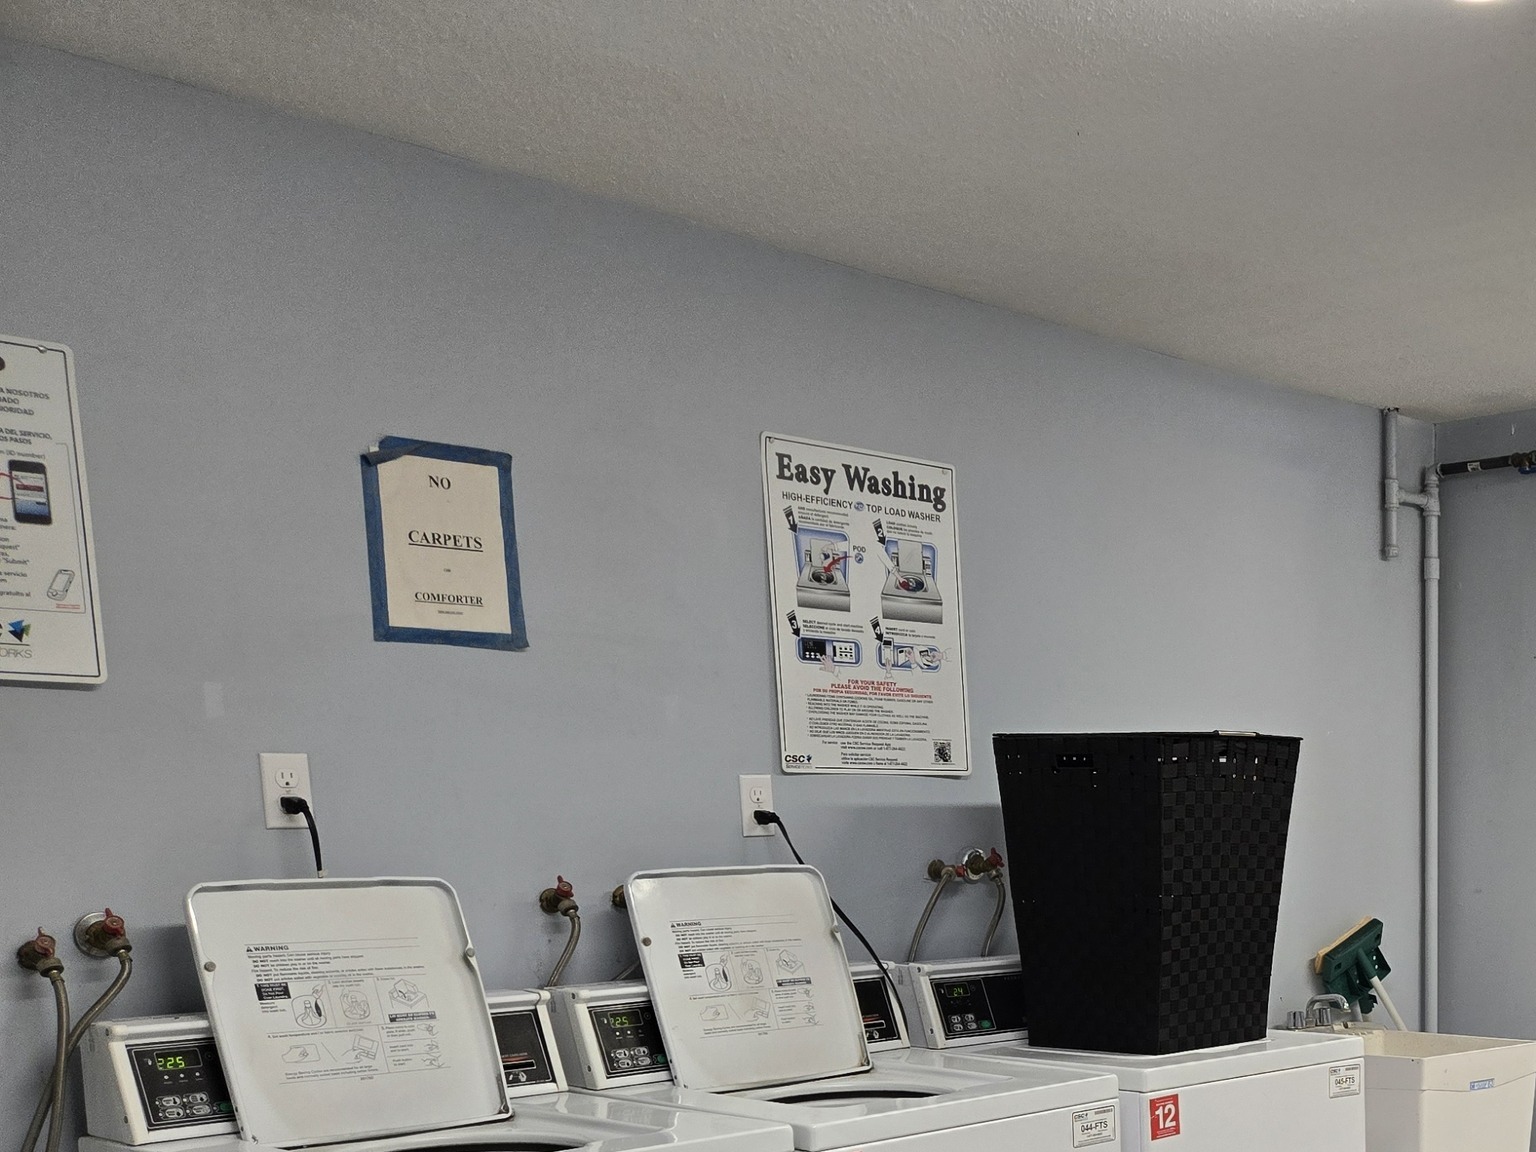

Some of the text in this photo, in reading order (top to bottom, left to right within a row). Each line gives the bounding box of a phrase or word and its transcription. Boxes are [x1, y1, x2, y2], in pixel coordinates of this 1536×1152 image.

[428, 475, 452, 490] NO
[775, 452, 947, 513] Easy Washing
[782, 491, 853, 510] HIGH-EFFICIENCY
[866, 504, 882, 514] TOP
[884, 507, 907, 517] LOAD
[908, 510, 941, 523] WASHER
[877, 528, 883, 538] 2
[408, 530, 483, 550] CARPETS
[852, 545, 867, 553] POD
[414, 592, 483, 605] COMFORTER
[791, 620, 797, 629] 3
[874, 626, 880, 634] 4
[883, 686, 914, 694] FOLLOWING
[784, 754, 805, 763] CSC
[1155, 1103, 1177, 1130] 12
[1080, 1120, 1109, 1133] 044-FTS
